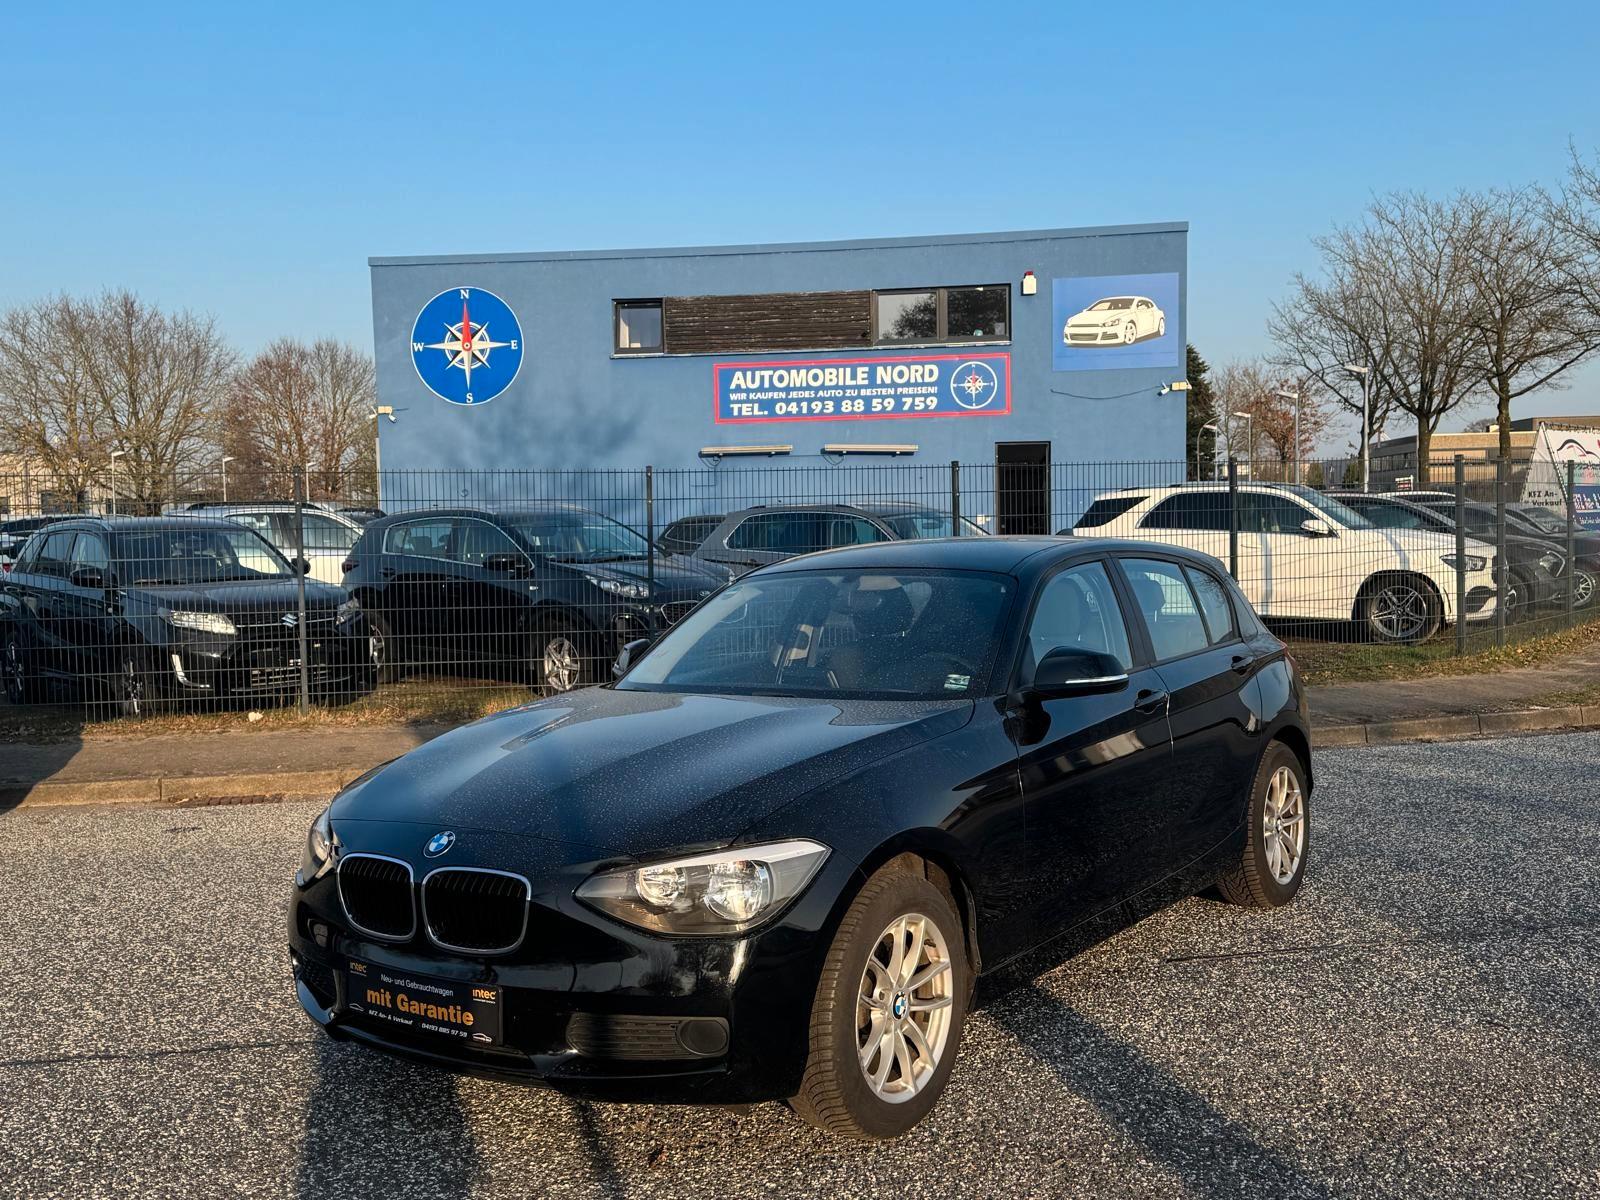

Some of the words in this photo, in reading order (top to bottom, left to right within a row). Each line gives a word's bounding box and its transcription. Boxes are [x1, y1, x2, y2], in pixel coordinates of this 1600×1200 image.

[460, 289, 469, 299] N
[412, 342, 424, 352] W
[511, 340, 518, 350] E
[729, 366, 869, 389] AUTOMOBILE
[876, 364, 939, 384] NORD
[466, 393, 473, 403] S
[729, 392, 747, 401] WIR
[749, 391, 786, 400] KAUFEN
[788, 390, 815, 399] JEDES
[817, 389, 843, 398] AUTO
[845, 388, 858, 397] ZU
[860, 387, 895, 396] BESTEN
[897, 386, 938, 395] PREISEN!
[730, 403, 768, 416] TEL.
[775, 400, 834, 415] 04193
[841, 399, 865, 413] 88
[872, 398, 895, 412] 59
[902, 396, 938, 411] 759
[1528, 490, 1541, 498] KFZ
[1544, 490, 1558, 498] An-
[1532, 498, 1562, 507] Verkauf
[380, 973, 393, 984] Neu-
[394, 979, 405, 987] und
[405, 979, 454, 997] Gebrauchtwagen
[472, 988, 496, 1000] intec
[367, 988, 392, 1008] mit
[397, 993, 474, 1026] Garantie
